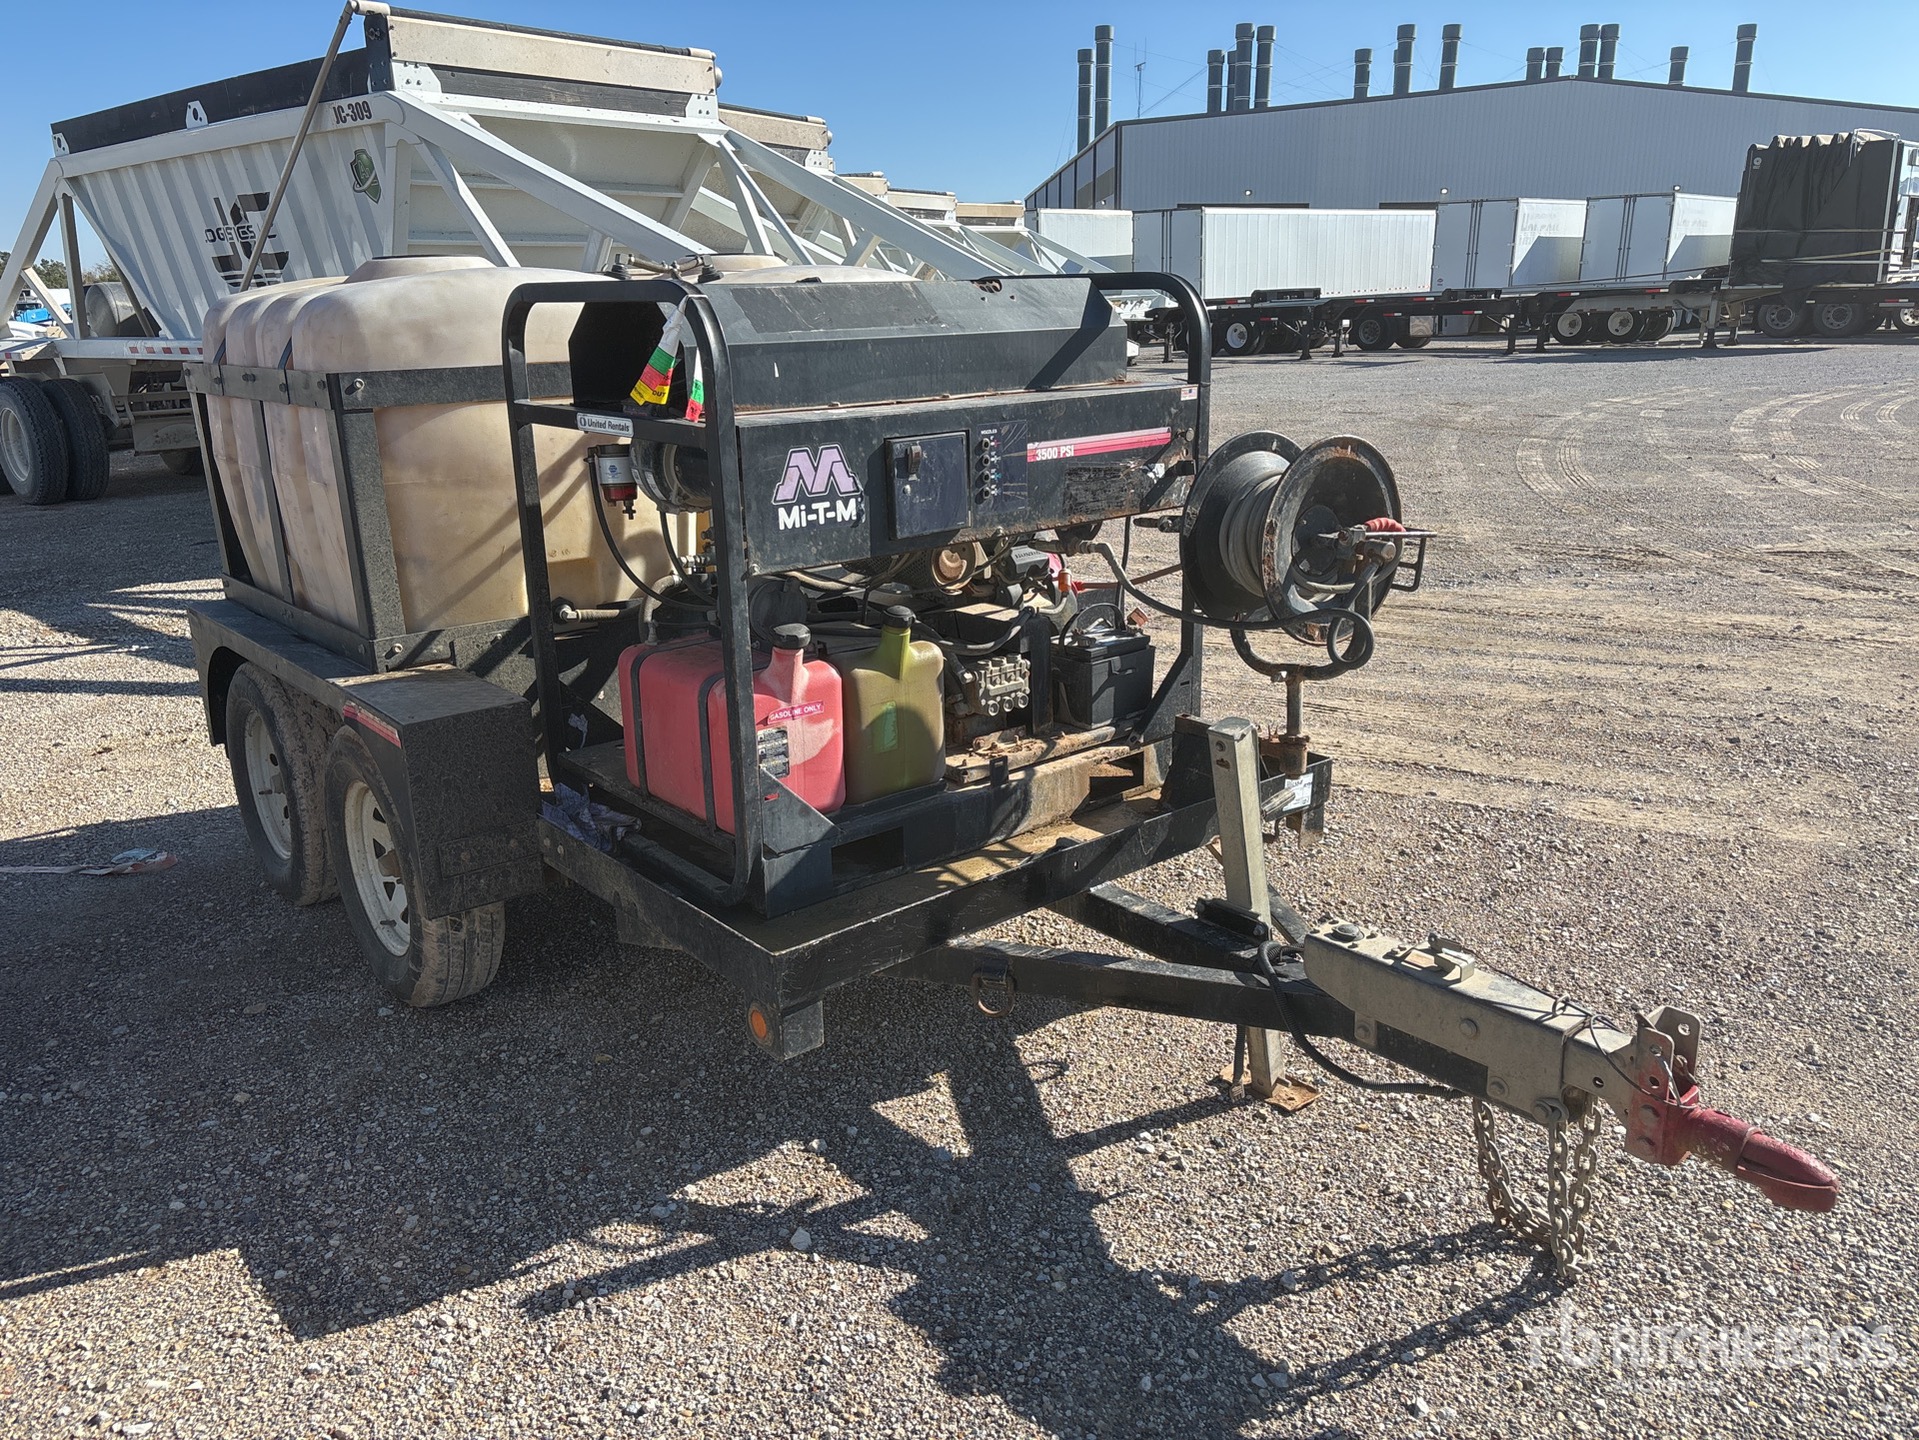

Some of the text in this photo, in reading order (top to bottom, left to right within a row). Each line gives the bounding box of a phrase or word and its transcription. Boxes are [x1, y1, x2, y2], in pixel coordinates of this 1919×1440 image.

[333, 100, 373, 125] JC-309
[587, 418, 630, 433] United Rentals
[1035, 444, 1075, 461] 3500 PSI
[778, 497, 858, 531] Mi-T-M
[803, 703, 822, 714] ONLY
